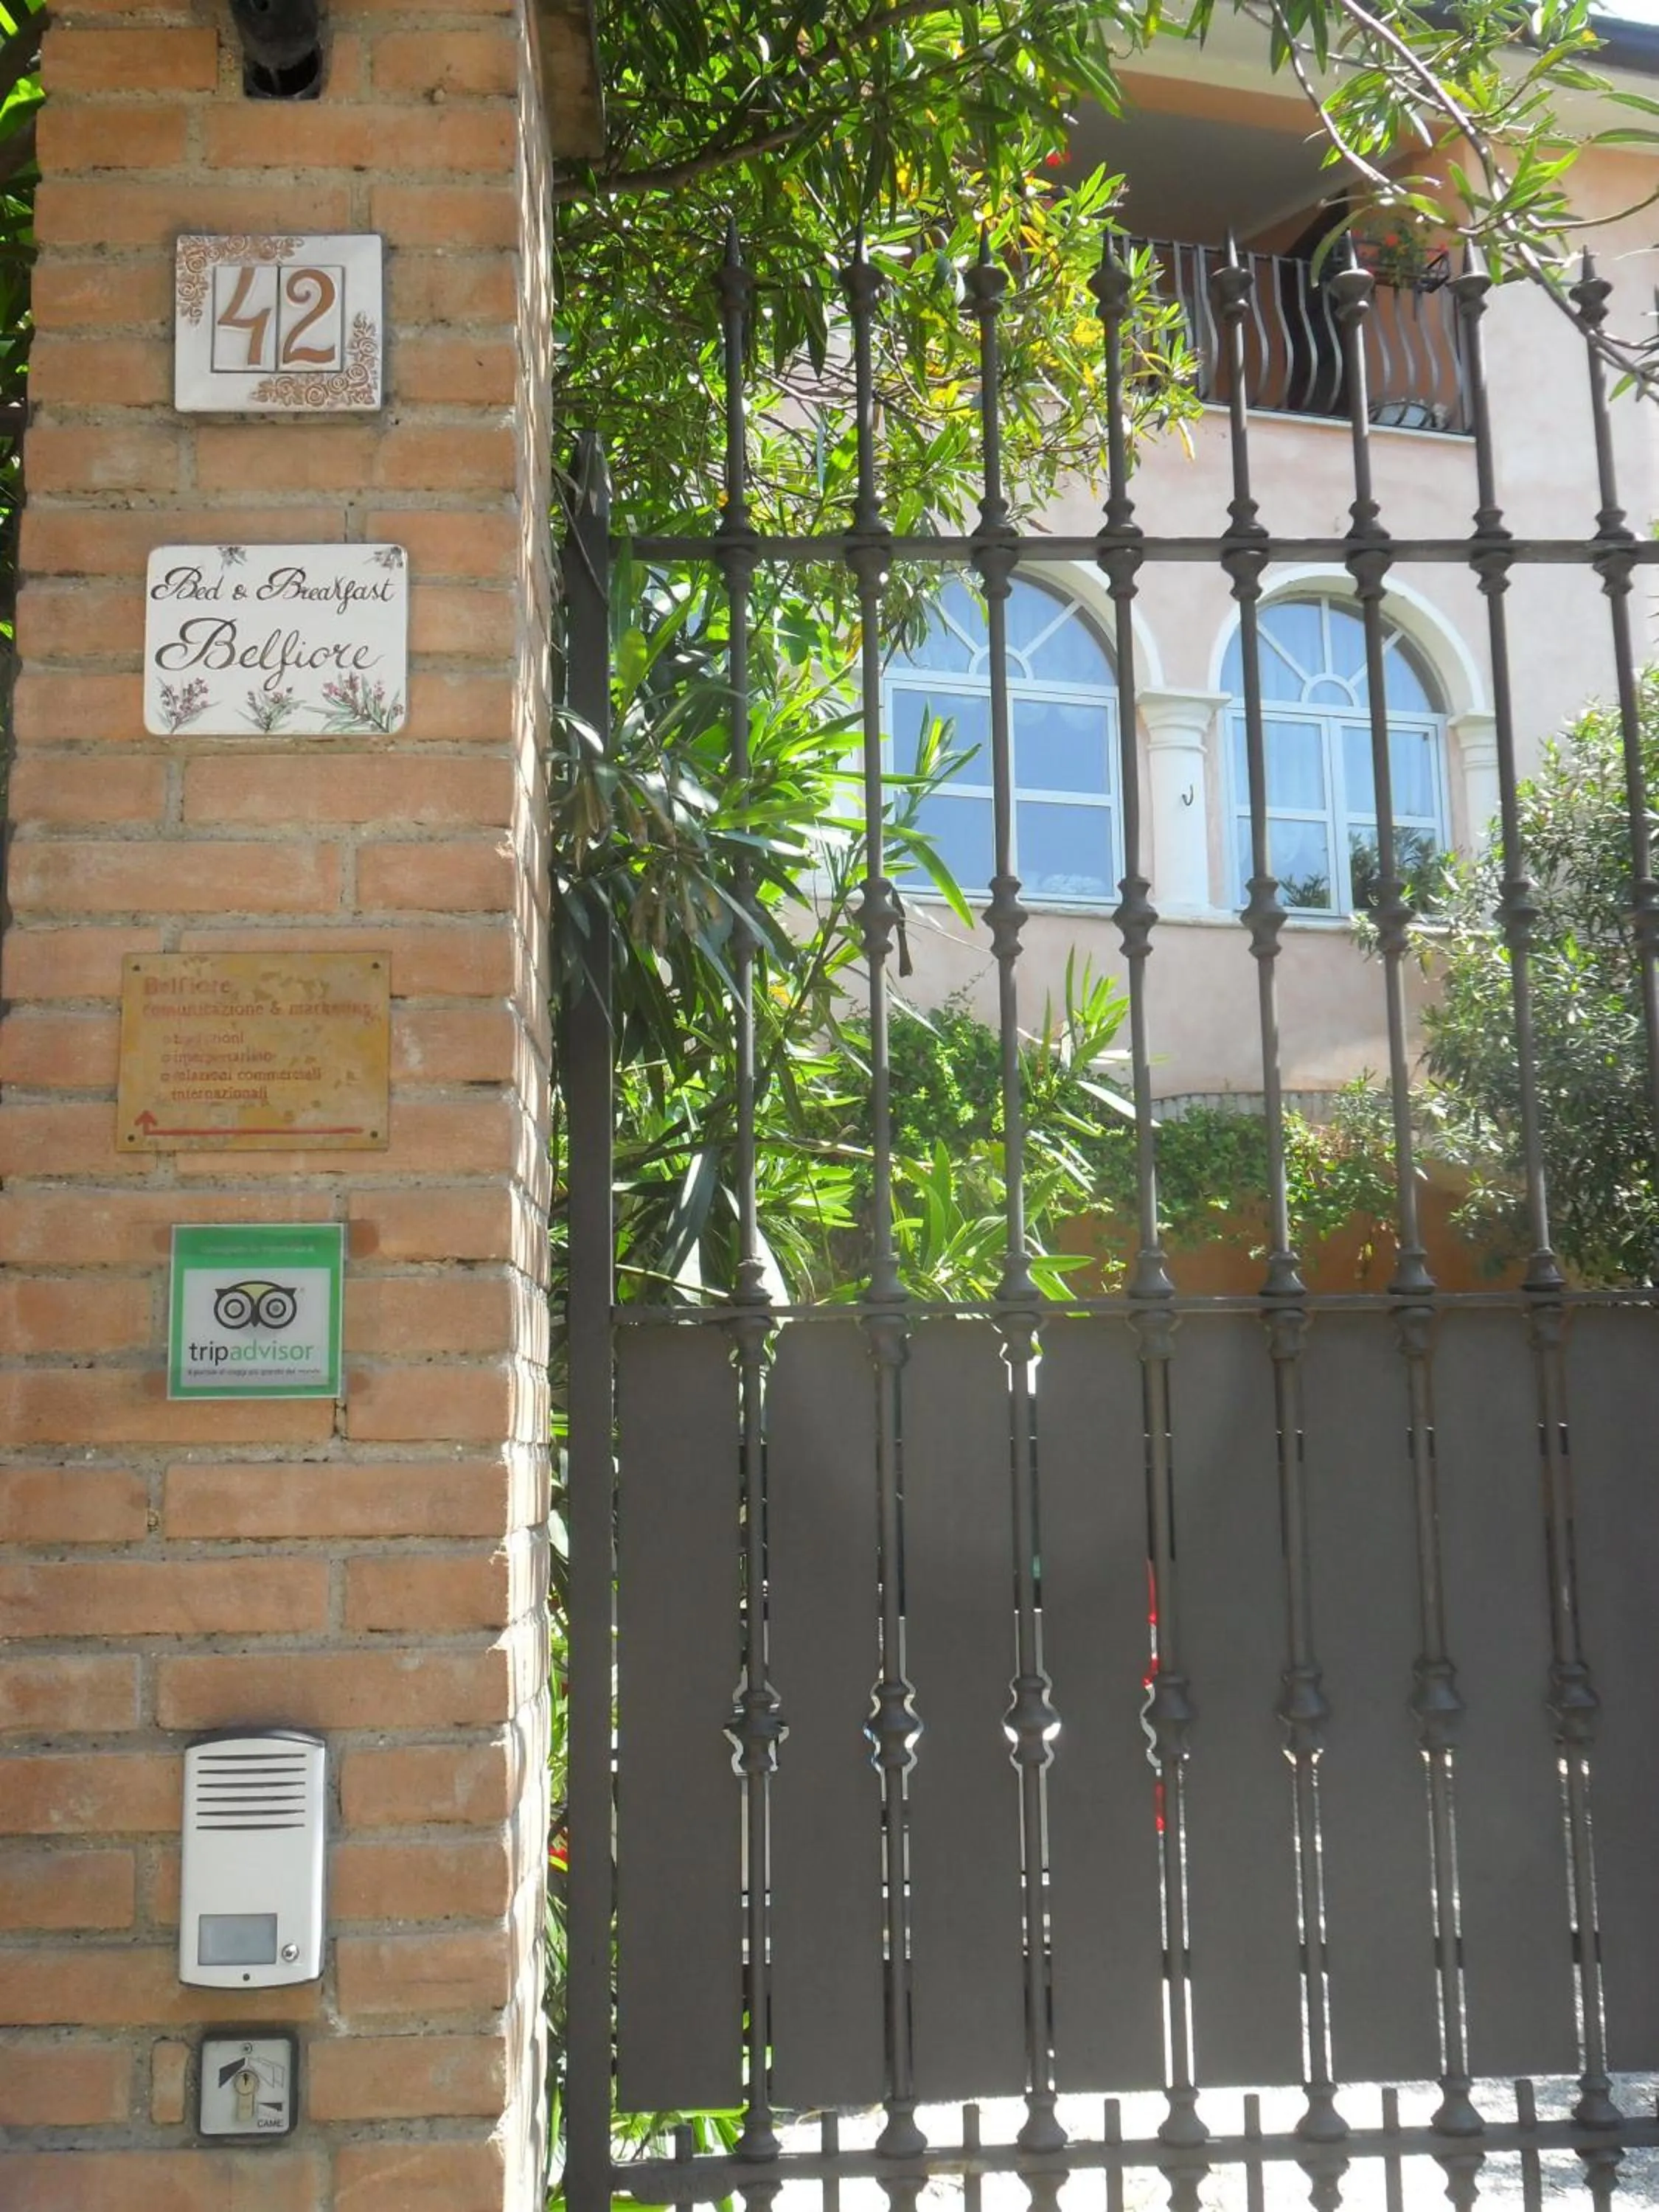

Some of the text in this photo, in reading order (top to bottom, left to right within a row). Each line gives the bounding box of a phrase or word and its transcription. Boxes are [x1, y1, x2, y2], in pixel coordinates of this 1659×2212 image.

[218, 266, 335, 366] 42
[150, 566, 396, 615] Bed & Breakfast
[154, 617, 386, 691] Belfiore
[270, 999, 281, 1015] &
[188, 1340, 315, 1366] tripadvisor
